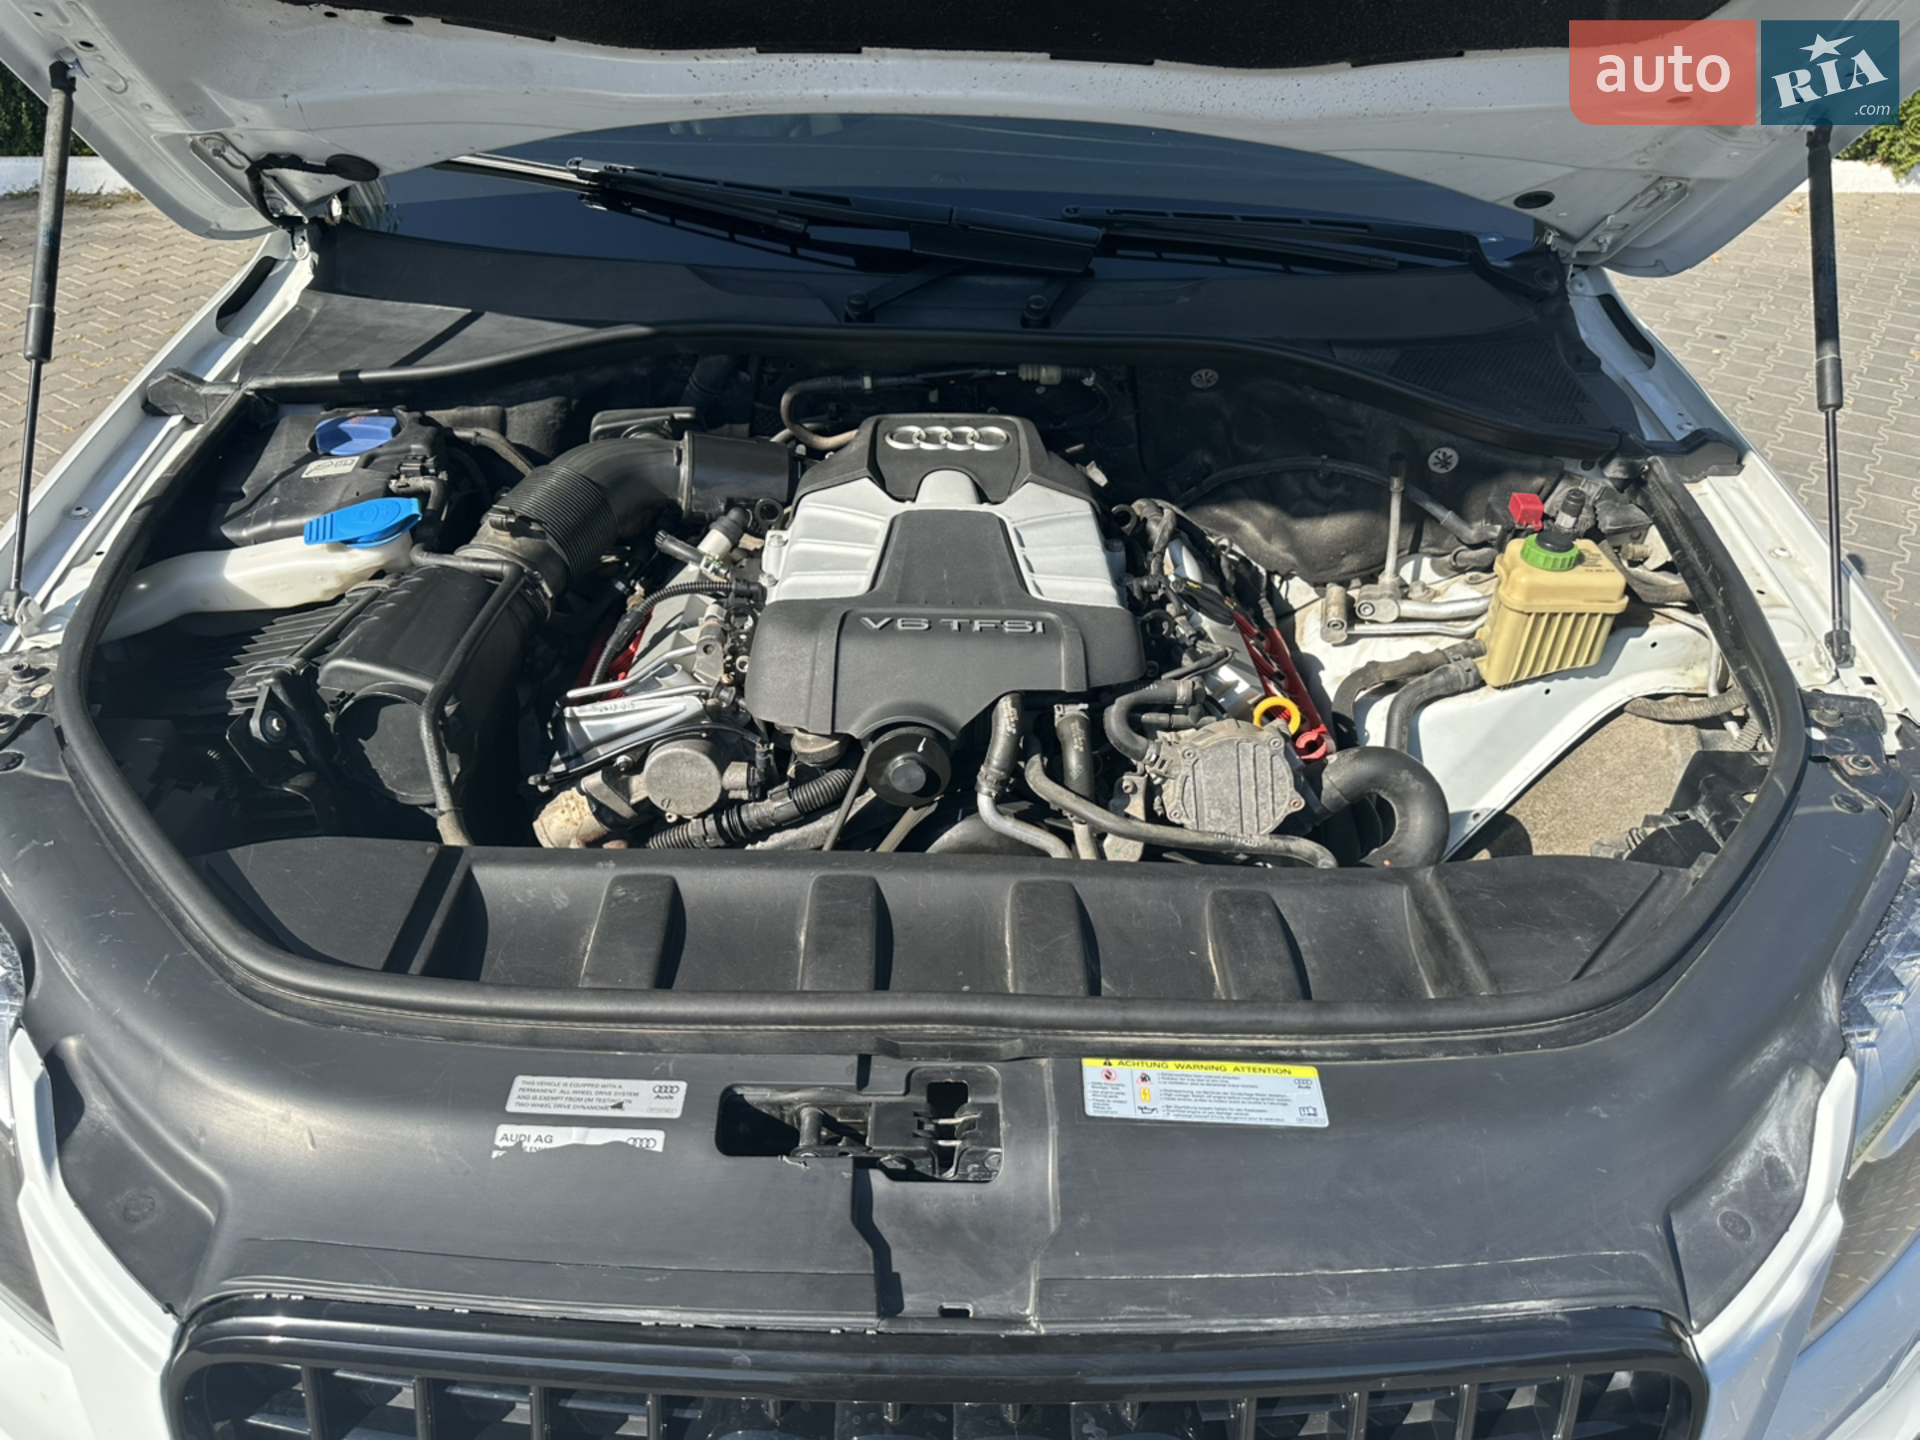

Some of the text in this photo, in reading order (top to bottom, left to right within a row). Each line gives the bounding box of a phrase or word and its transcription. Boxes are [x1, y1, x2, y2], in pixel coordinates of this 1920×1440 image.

[860, 616, 1045, 633] V6 TFSI
[1118, 1060, 1292, 1075] ACHTUNG WARNING ATTENTION
[500, 1132, 554, 1144] AUDI AG
